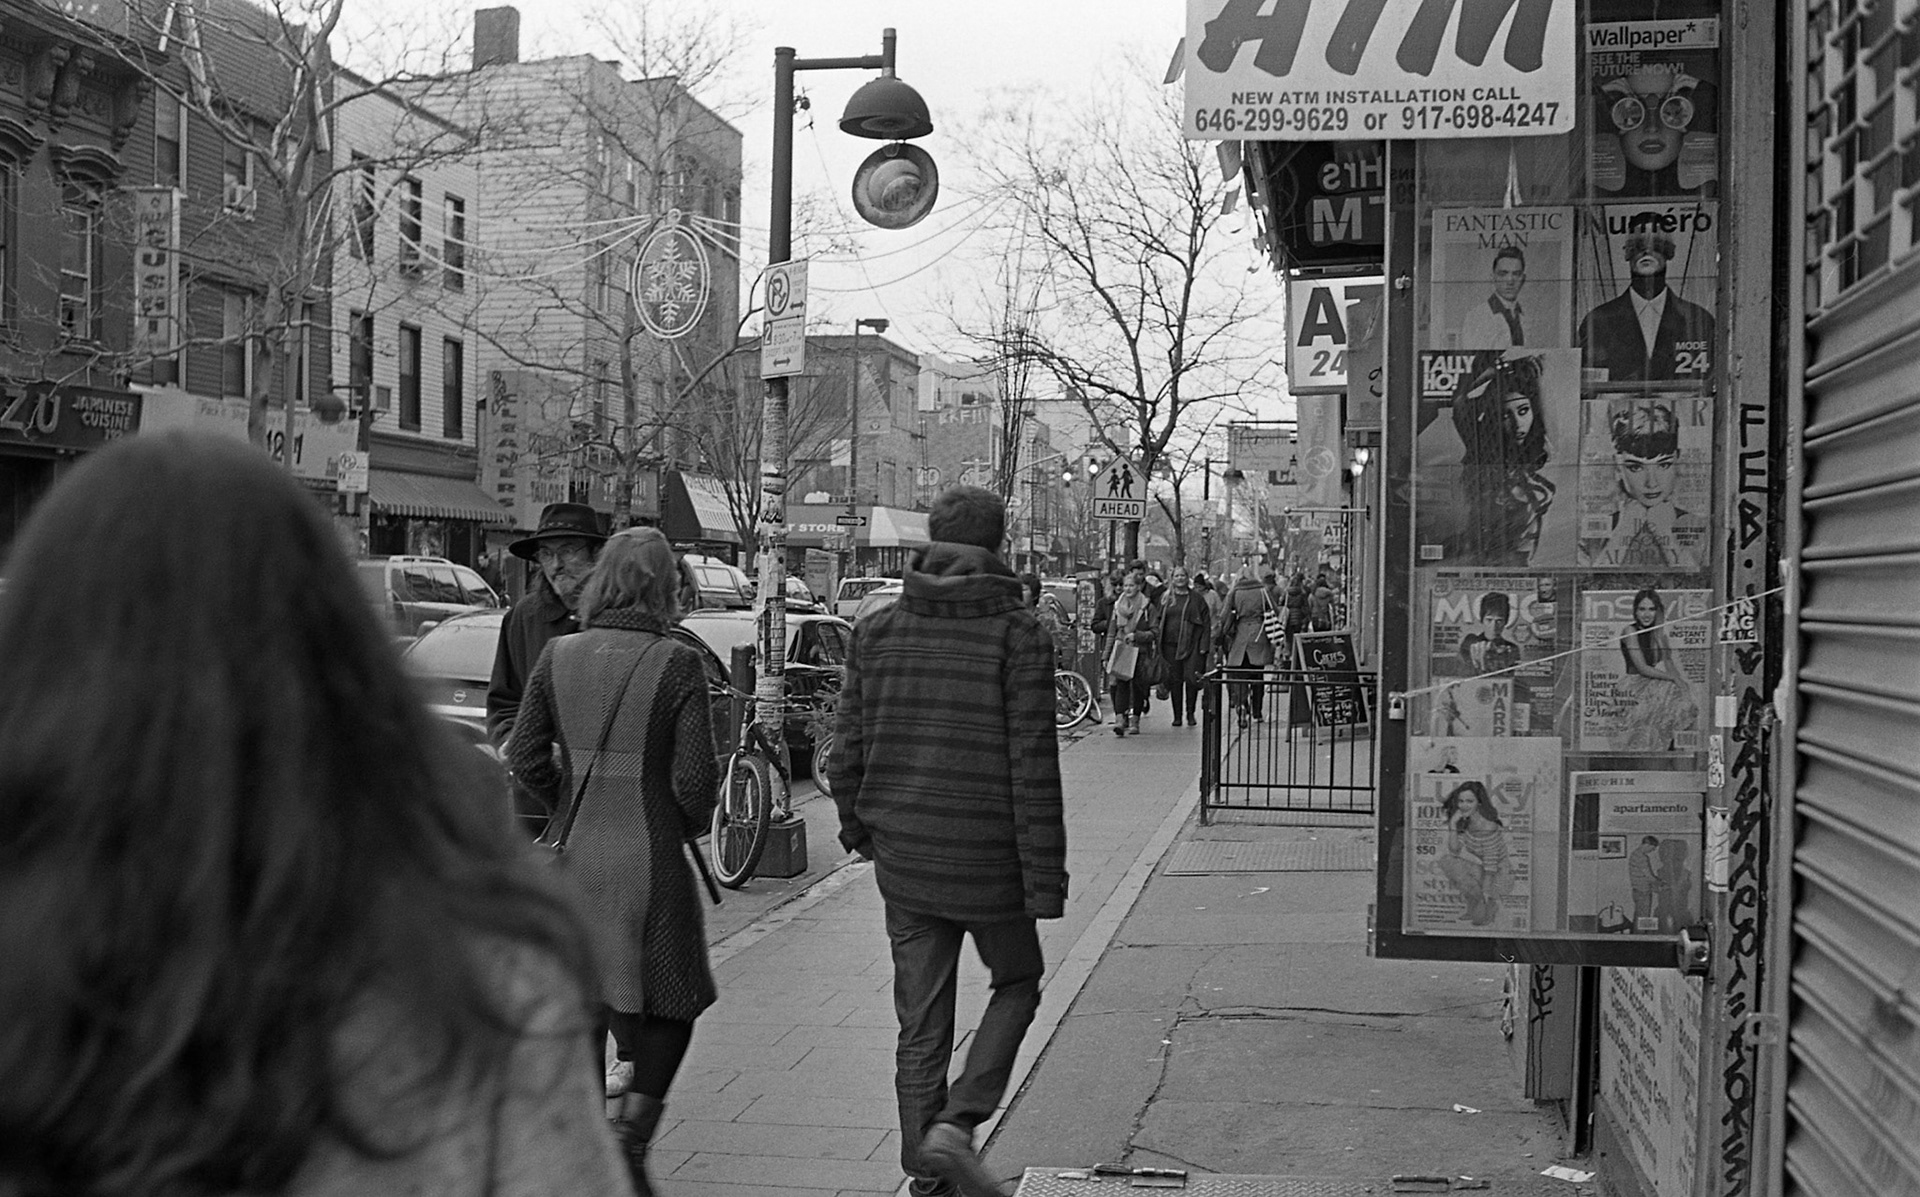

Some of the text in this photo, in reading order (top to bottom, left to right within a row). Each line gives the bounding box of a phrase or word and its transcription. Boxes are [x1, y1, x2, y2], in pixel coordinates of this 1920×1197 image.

[1592, 51, 1641, 64] SEE THE
[1592, 62, 1685, 76] FUTURE NOW!
[1231, 87, 1521, 105] NEW ATM INSTALLATION CALL
[1195, 102, 1560, 132] 646-299-9629 or 917-698-4247
[1446, 212, 1563, 232] FANTASTIC
[1477, 230, 1529, 250] MAN
[1675, 341, 1708, 351] MODE
[1309, 349, 1348, 377] 24
[1421, 355, 1476, 374] TALLY
[1674, 351, 1710, 374] 24
[1423, 373, 1460, 391] HO!
[72, 395, 134, 416] JAPANESE
[82, 411, 131, 430] CUISINE
[1100, 502, 1139, 516] AHEAD
[798, 523, 846, 532] STORE
[1453, 578, 1536, 588] 2013 PREVIEW
[1585, 595, 1708, 619] InSle
[1670, 630, 1706, 638] INSTANT
[1683, 637, 1706, 645] SEXY
[1413, 773, 1535, 812] Luky
[1613, 804, 1689, 815] apartamento
[1416, 846, 1436, 856] $50
